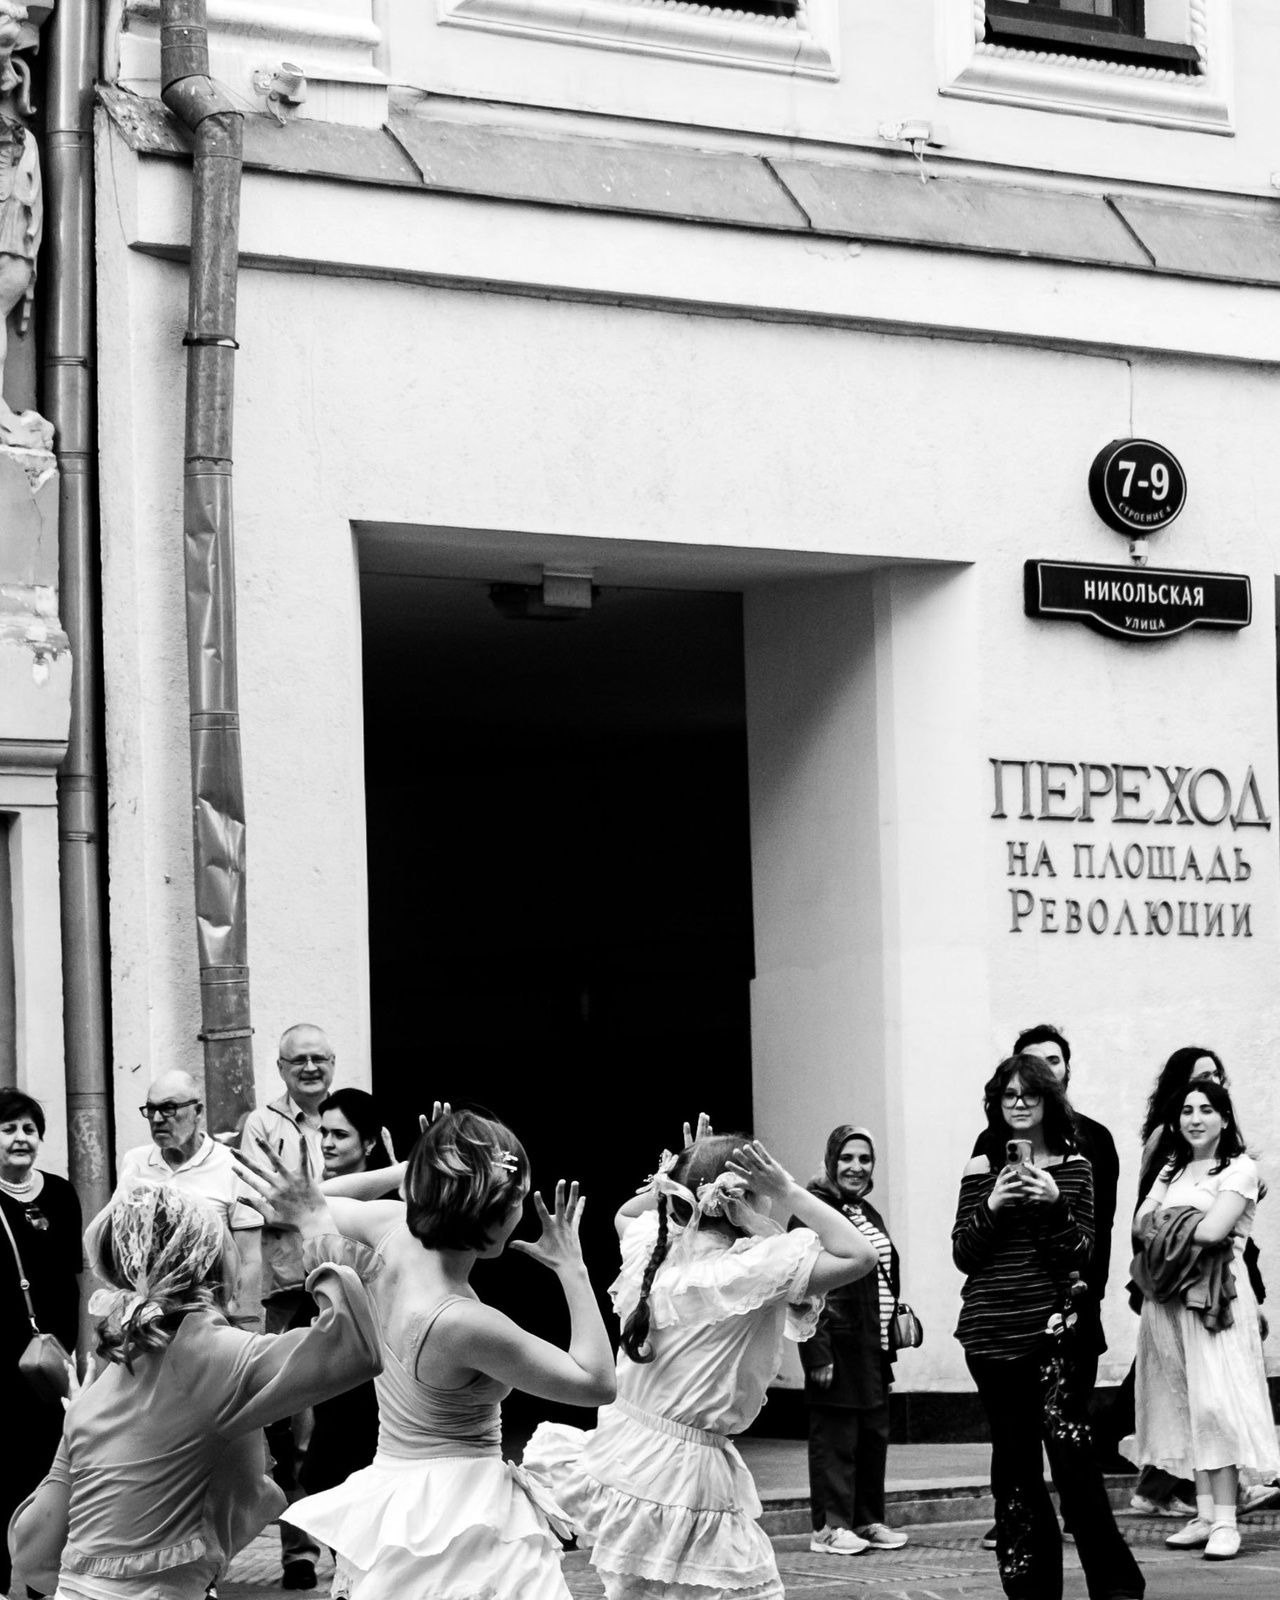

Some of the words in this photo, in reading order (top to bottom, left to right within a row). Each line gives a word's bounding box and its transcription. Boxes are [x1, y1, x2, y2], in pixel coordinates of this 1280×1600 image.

[1119, 460, 1170, 501] 7-9
[1118, 502, 1165, 523] СТРОЕНИЕ
[1084, 580, 1204, 606] НИКОЛЬСКАЯ
[1125, 616, 1165, 631] УЛИЦА
[988, 757, 1272, 832] ПЕРЕХОД
[1006, 840, 1057, 877] НА
[1073, 842, 1252, 883] ПЛОЩАДЬ
[1008, 888, 1253, 938] РЕВОЛЮЦИИ
